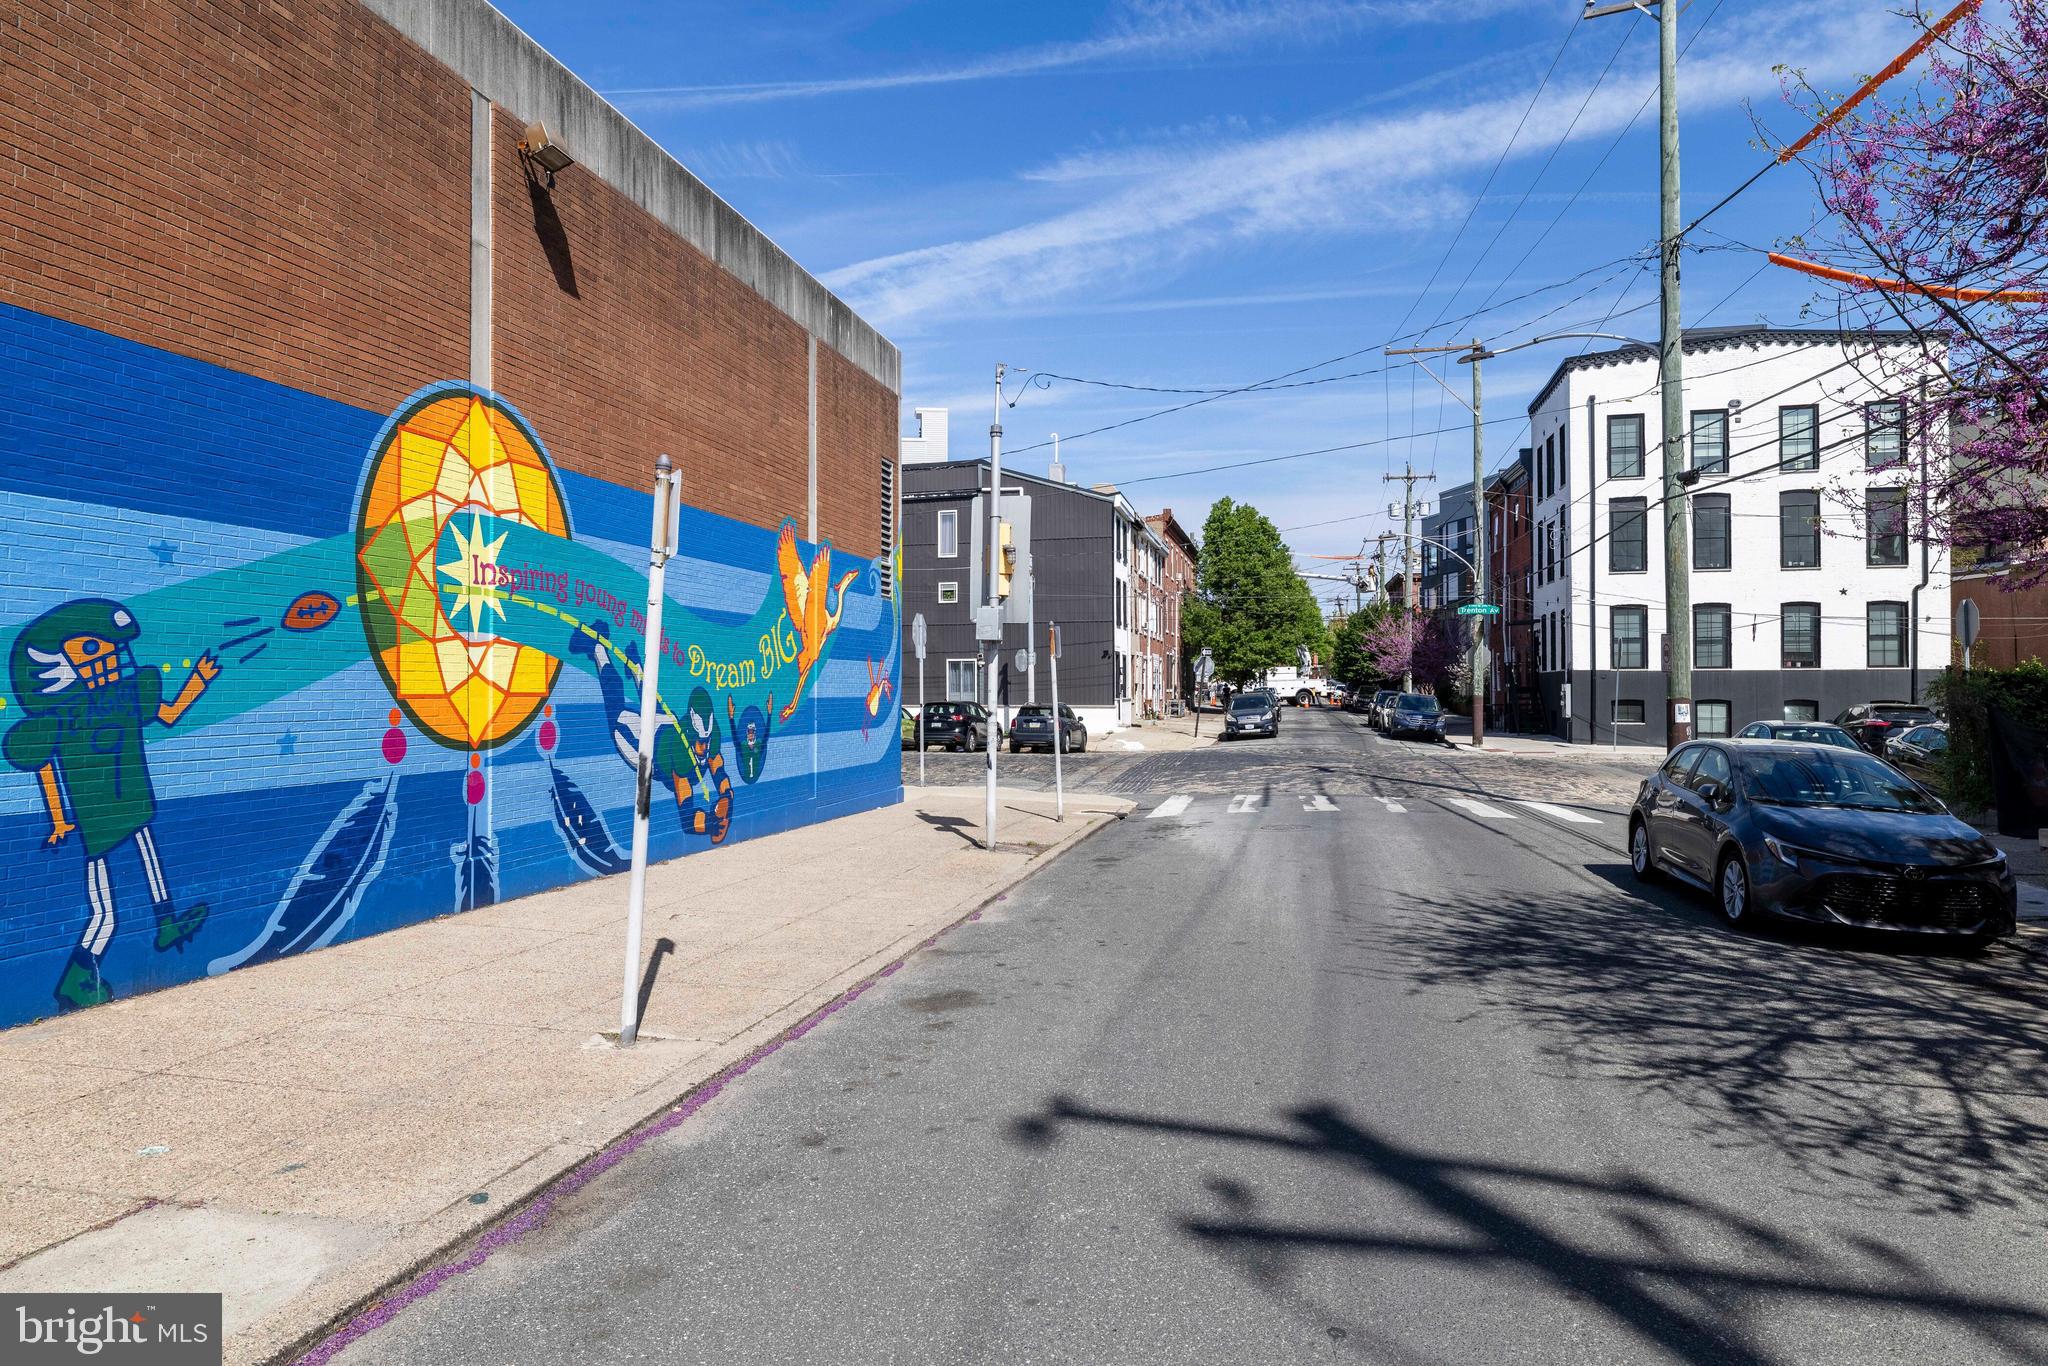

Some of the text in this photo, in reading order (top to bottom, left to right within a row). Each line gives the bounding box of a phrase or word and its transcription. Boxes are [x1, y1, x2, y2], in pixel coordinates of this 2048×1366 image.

[472, 554, 569, 602] Inspiring
[574, 579, 627, 627] young
[672, 641, 685, 667] to
[688, 607, 798, 690] Dream BIG
